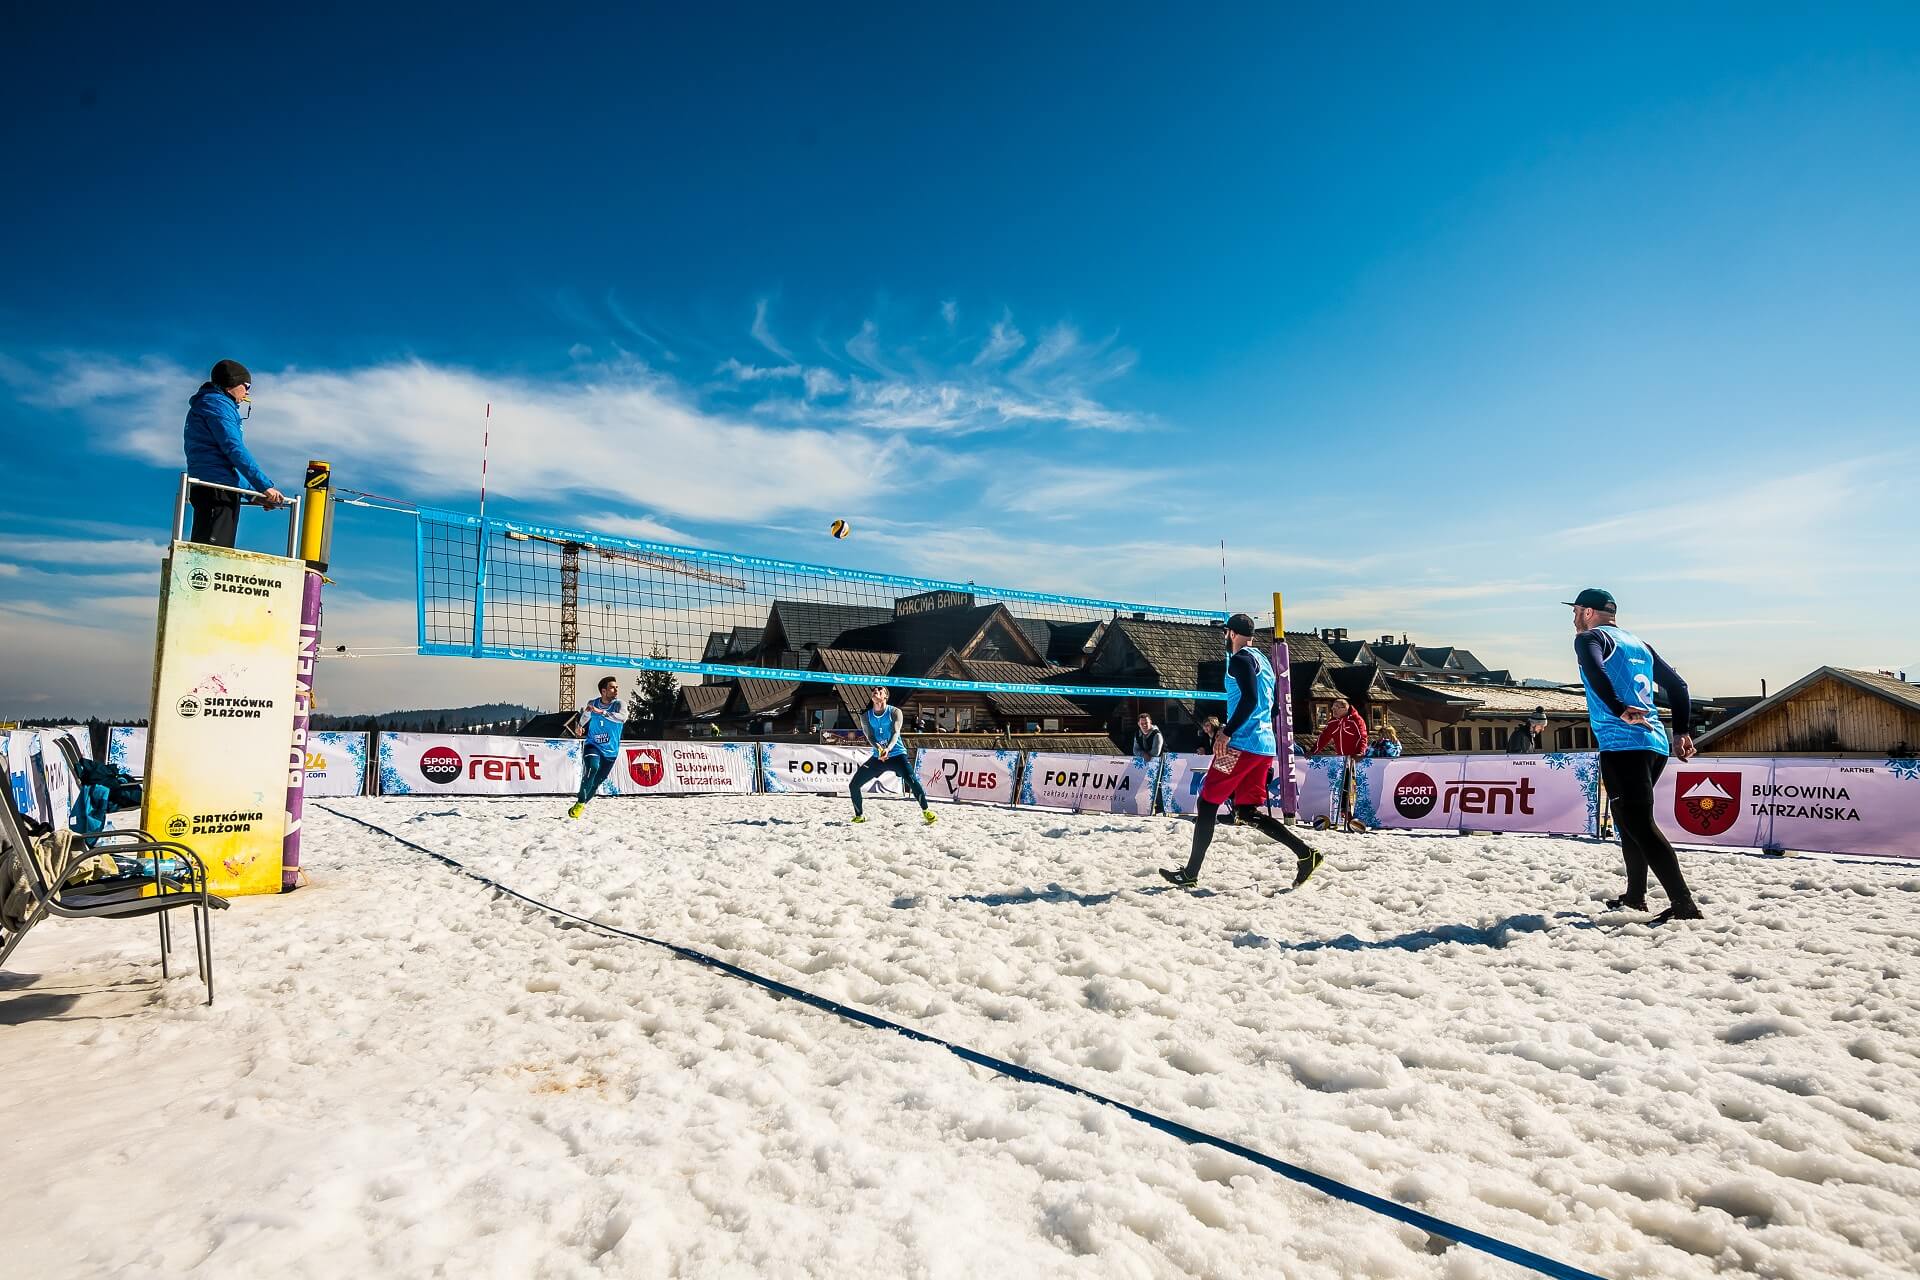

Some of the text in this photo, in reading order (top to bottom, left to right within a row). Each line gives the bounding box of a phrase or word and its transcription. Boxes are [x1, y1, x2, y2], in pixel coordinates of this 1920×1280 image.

[214, 572, 282, 589] SIATKÓWKA
[214, 582, 270, 598] PLAŻOWA
[896, 595, 935, 617] KARCMA
[1633, 673, 1651, 705] 2
[204, 695, 273, 709] SIATKÓWKA
[203, 707, 261, 719] PLAŻOWA
[423, 757, 459, 765] SPORT
[673, 749, 708, 760] Gmina
[426, 765, 456, 773] 2000
[468, 754, 542, 781] rent
[675, 762, 725, 773] Bukowina
[942, 758, 997, 794] RULES
[1044, 770, 1130, 791] FORTUNA
[1043, 789, 1069, 799] zakłady
[1397, 786, 1435, 796] SPORT
[1442, 777, 1536, 815] rent
[1752, 784, 1851, 801] BUKOWINA
[1399, 796, 1431, 805] 2000
[192, 810, 263, 823] SIATKÓWKA
[1750, 803, 1861, 821] TATRZAŃSKA
[192, 822, 251, 835] PLAŻOWA
